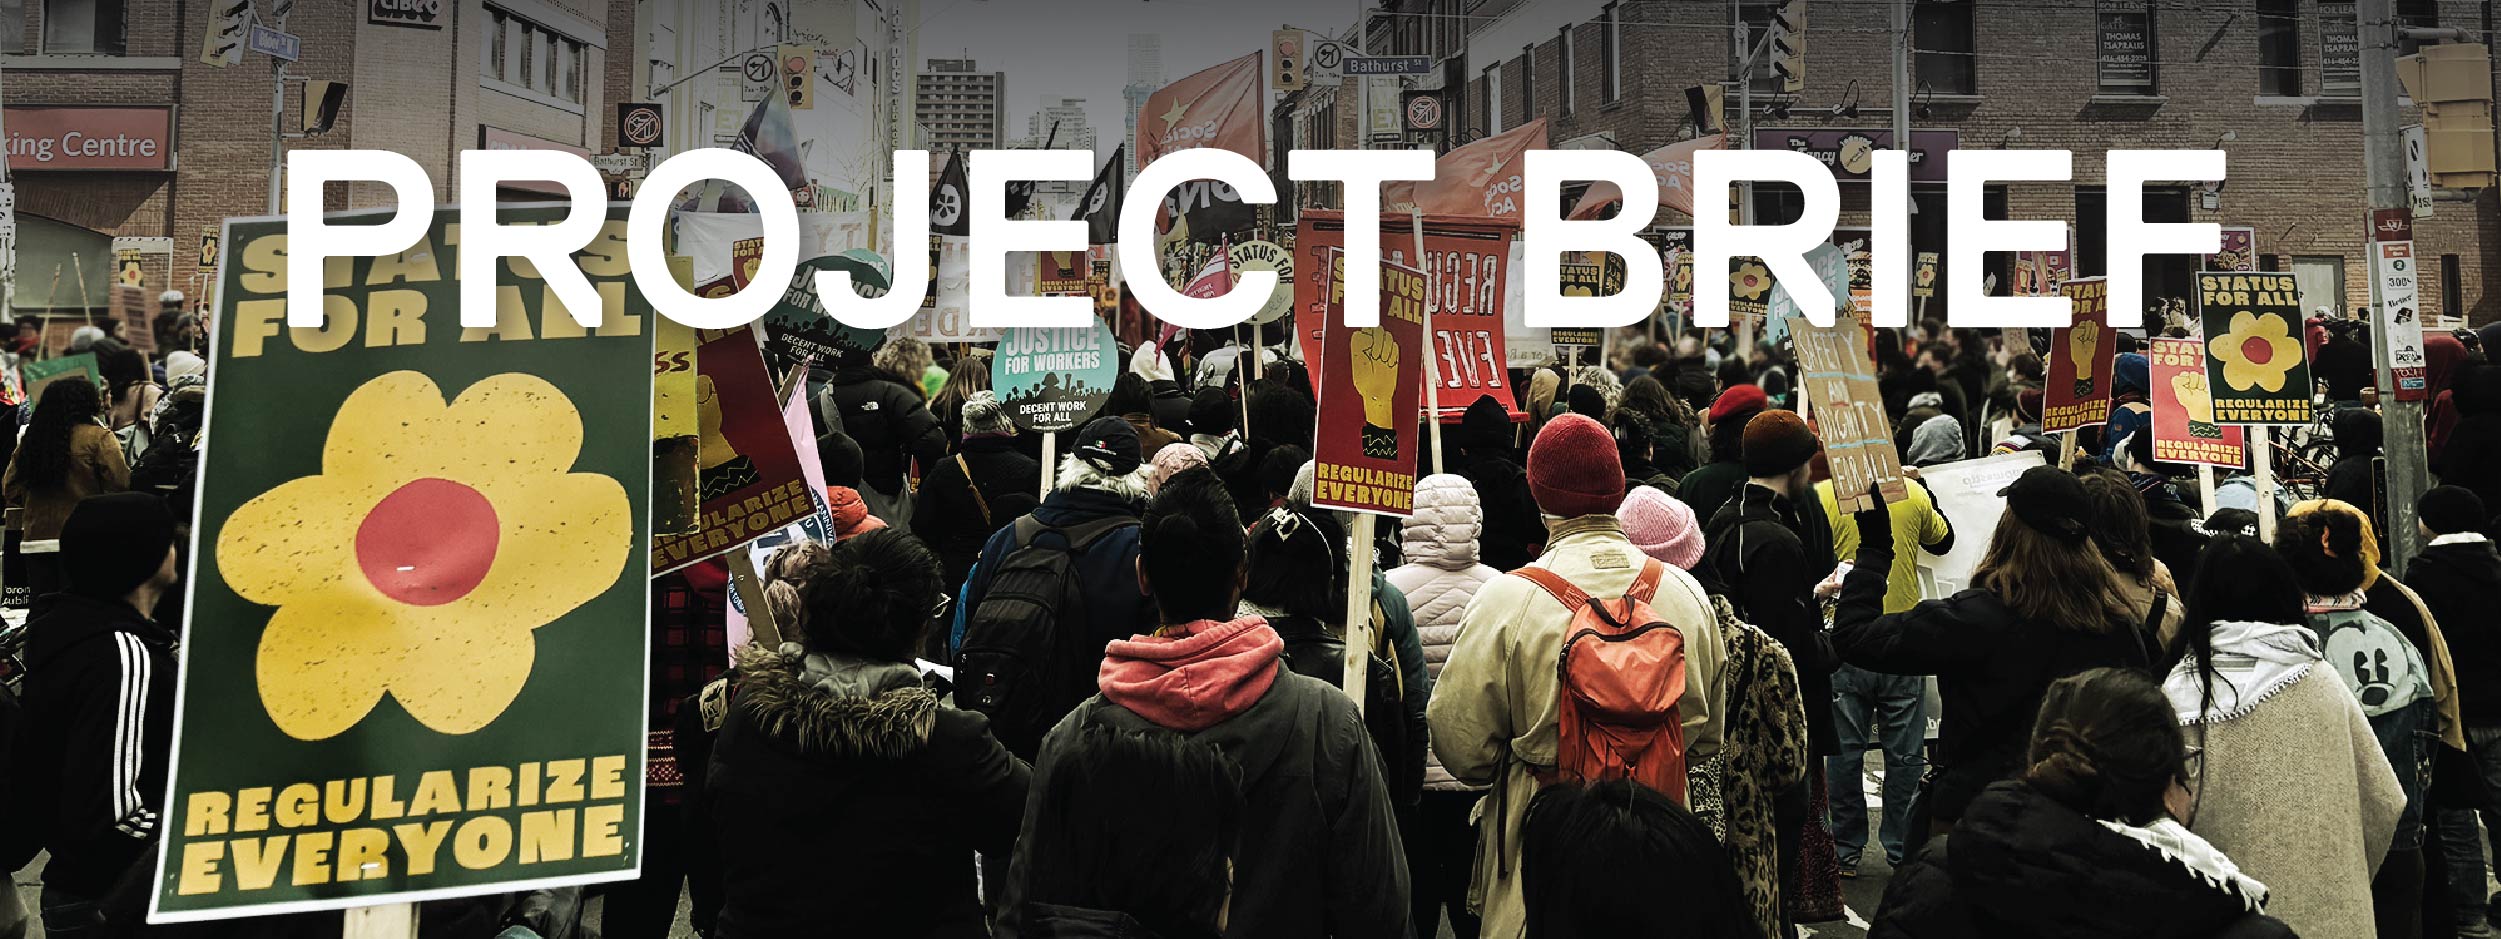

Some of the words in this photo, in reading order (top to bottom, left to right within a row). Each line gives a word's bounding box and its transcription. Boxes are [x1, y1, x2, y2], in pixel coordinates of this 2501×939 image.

[2106, 32, 2141, 40] THOMAS
[2327, 34, 2358, 43] THOMA
[1350, 59, 1409, 73] Bathurst
[62, 131, 156, 157] Centre
[1229, 244, 1278, 269] STATUS
[1273, 257, 1294, 284] FOR
[1559, 265, 1599, 276] TATUS
[2202, 275, 2295, 292] STATUS
[2203, 291, 2250, 307] FOR
[2257, 291, 2299, 307] ALL
[1387, 301, 1423, 325] ALL
[781, 333, 818, 350] DECENT
[1005, 321, 1100, 356] JUSTICE
[1797, 328, 1861, 376] SAFETY
[2153, 354, 2195, 367] FOR
[1005, 355, 1030, 375] FOR
[1034, 350, 1101, 372] WORKERS
[1019, 401, 1056, 415] DECENT
[1058, 400, 1087, 412] WORK
[2045, 399, 2107, 417] REGULARIZE
[2214, 398, 2310, 410] REGULARIZE
[1033, 412, 1052, 423] FOR
[1053, 411, 1072, 422] ALL
[1818, 400, 1888, 443] DIGNITY
[2044, 409, 2106, 430] EVERYONE
[2214, 409, 2311, 421] EVERYONE
[2155, 439, 2241, 455] REGULARIZE
[2155, 448, 2241, 465] EVERYONE
[1317, 462, 1414, 492] REGULARIZE
[1832, 455, 1866, 496] FOR
[1862, 453, 1898, 485] ALL
[1316, 479, 1413, 511] EVERYONE
[652, 493, 812, 569] EVERYONE
[183, 755, 626, 837] REGULARIZE
[177, 804, 625, 896] EVERYONE
